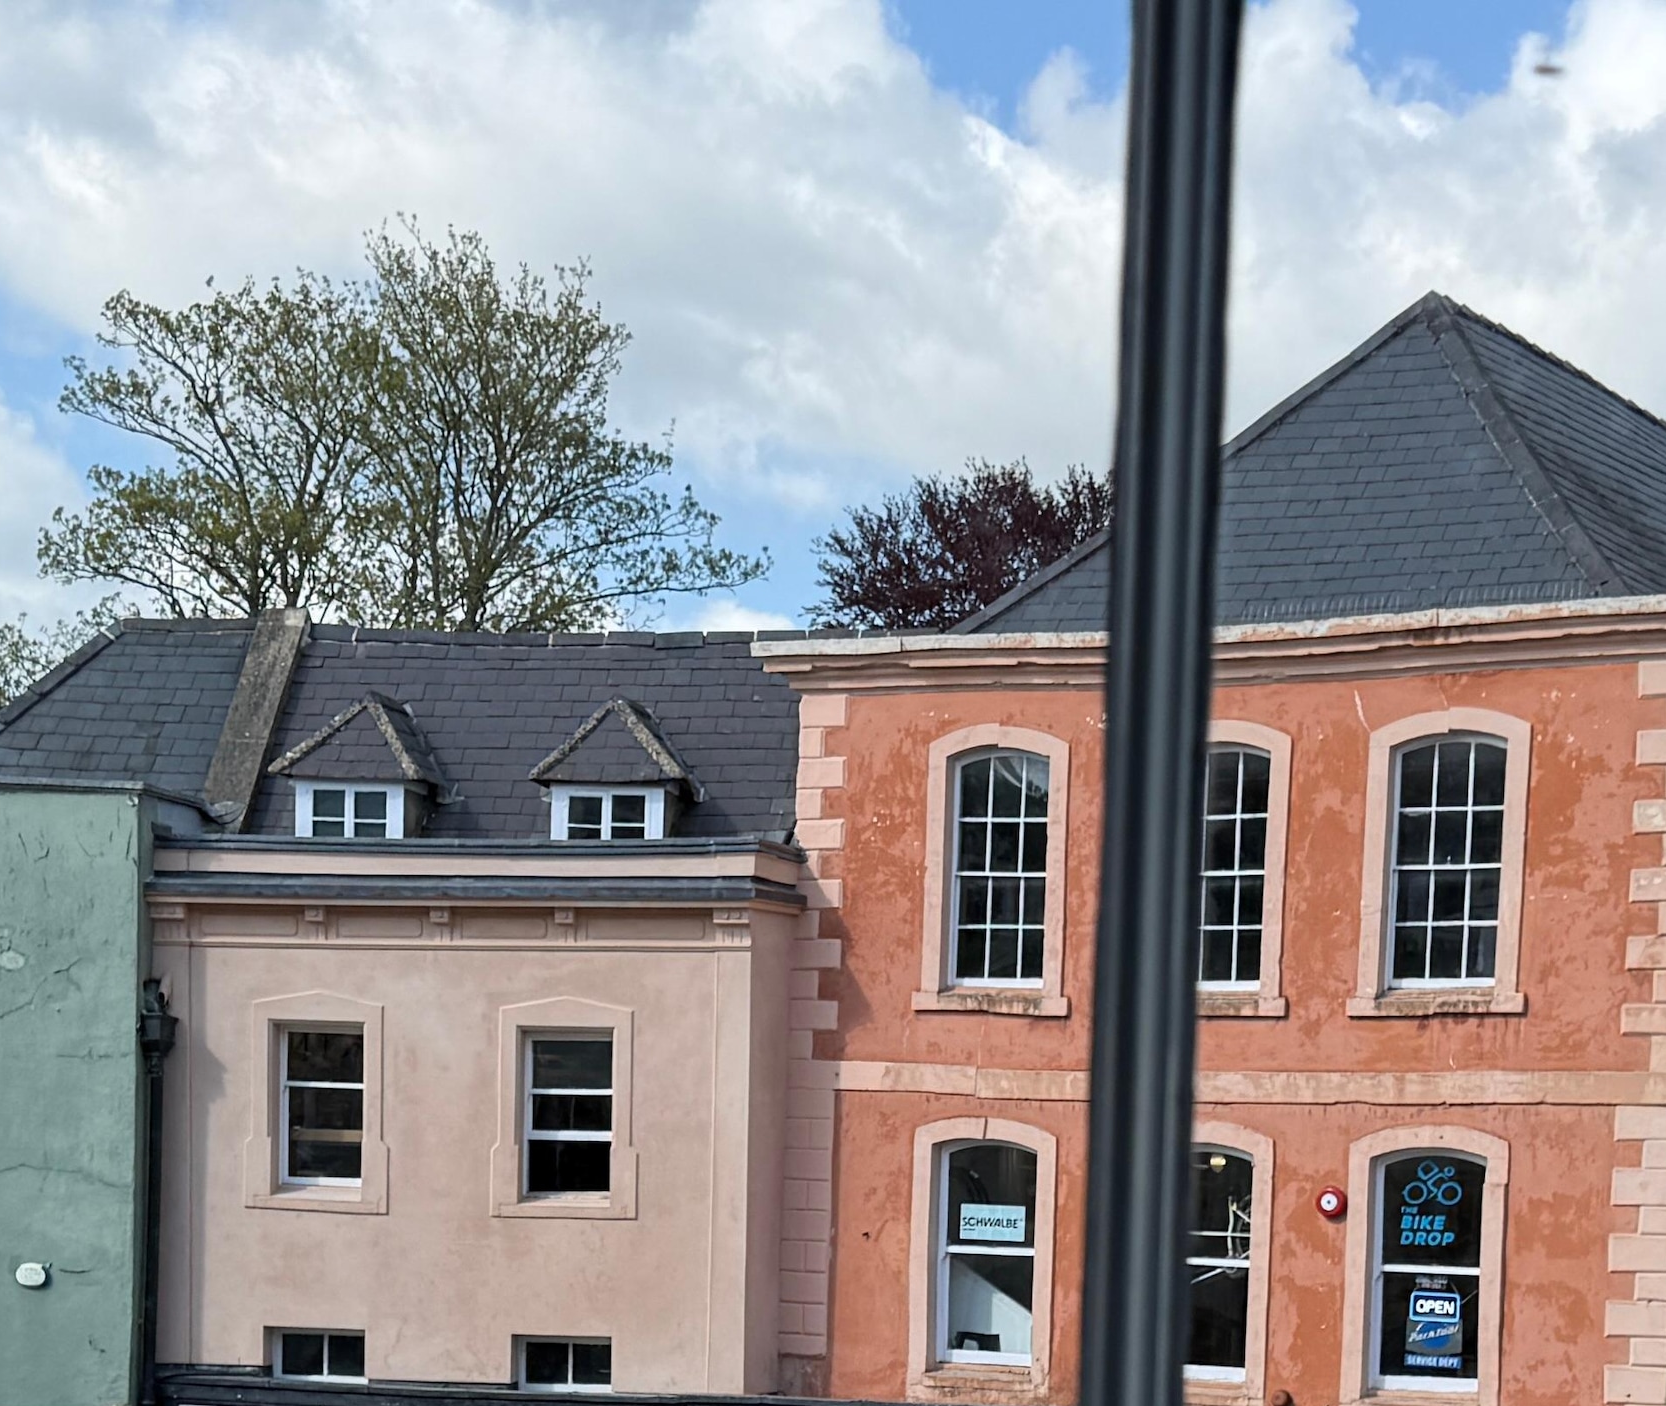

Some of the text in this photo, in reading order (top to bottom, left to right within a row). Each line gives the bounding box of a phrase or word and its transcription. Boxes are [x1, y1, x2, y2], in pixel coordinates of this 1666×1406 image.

[1400, 1215, 1446, 1230] BIKE
[1400, 1231, 1455, 1246] DROP
[1415, 1299, 1455, 1315] OPEN
